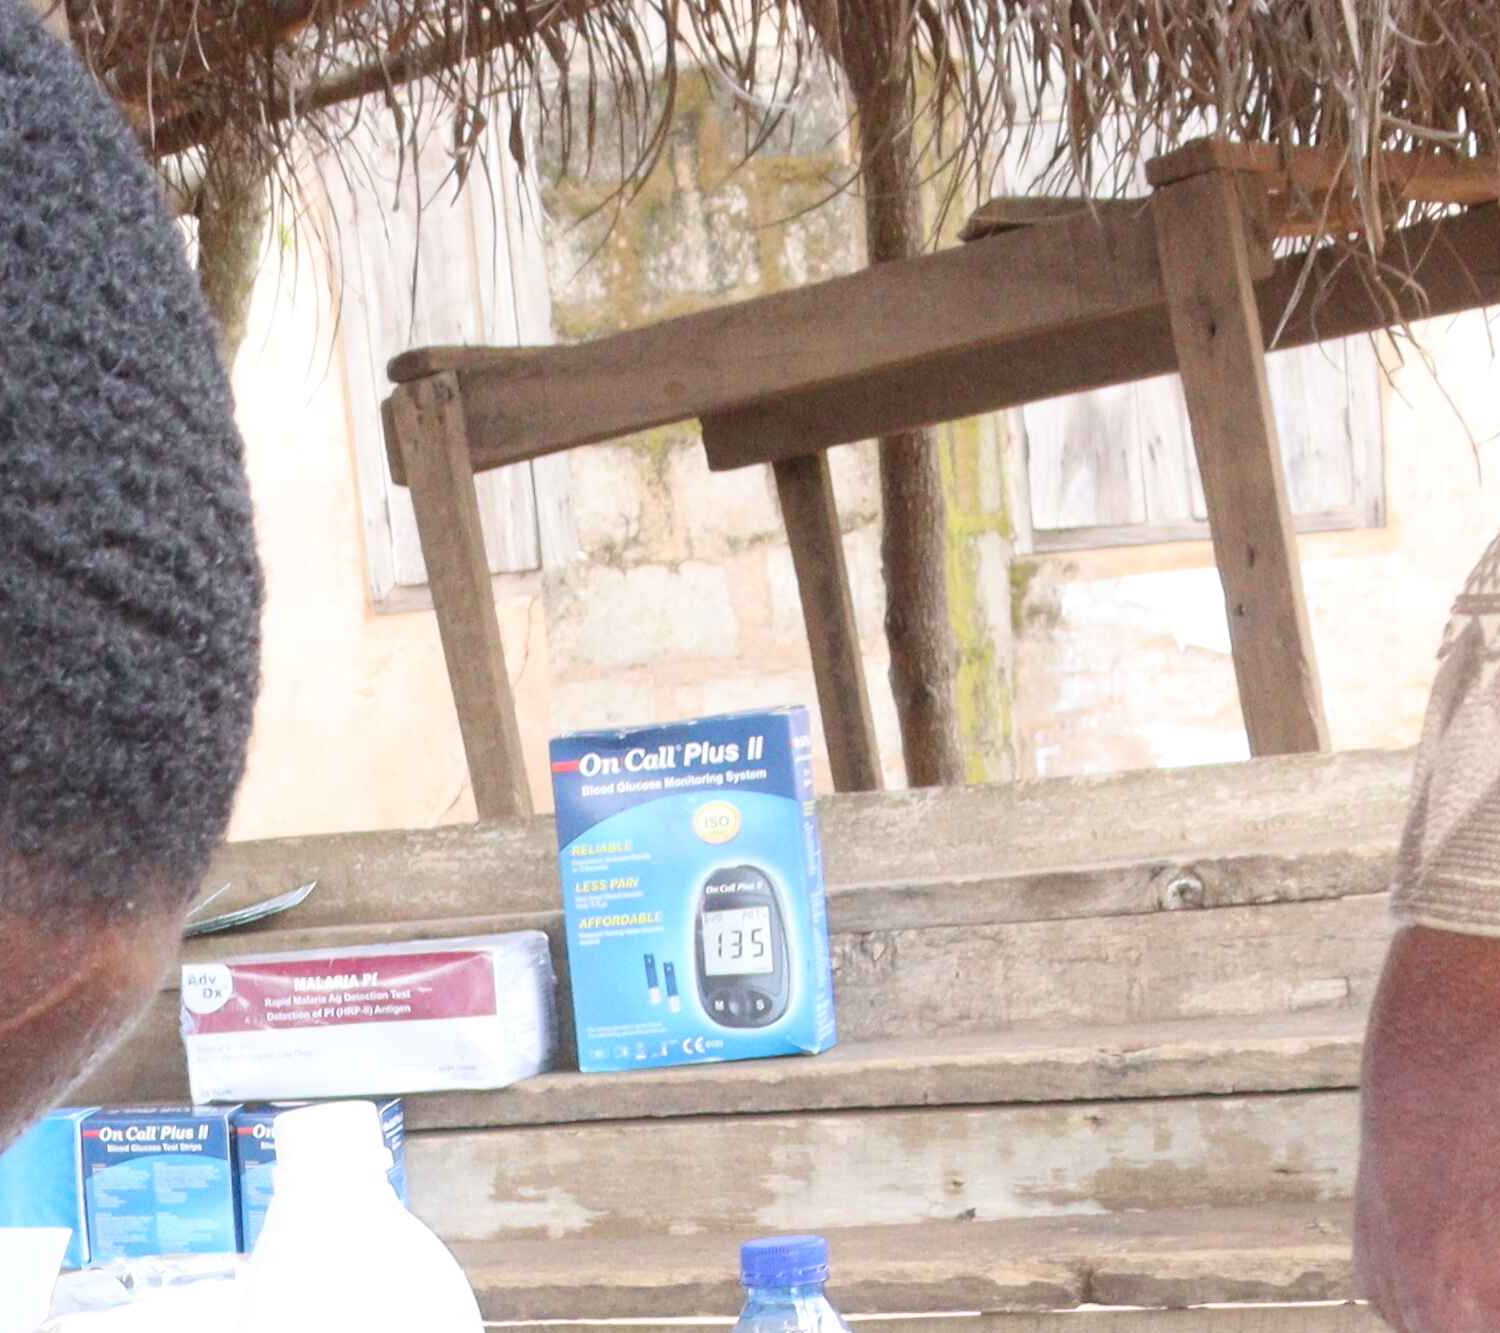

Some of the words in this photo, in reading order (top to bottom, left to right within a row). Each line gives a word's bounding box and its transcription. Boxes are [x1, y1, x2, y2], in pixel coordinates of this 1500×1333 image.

[578, 753, 620, 778] On
[625, 745, 676, 772] Call
[683, 743, 740, 768] Plus
[747, 736, 764, 760] II
[581, 781, 614, 797] Blood
[616, 779, 662, 794] Glucose
[664, 773, 723, 790] Monitoring
[725, 768, 767, 785] System
[703, 815, 730, 829] ISO
[576, 880, 608, 893] LESS
[717, 928, 765, 959] 135
[187, 973, 217, 987] Adv
[293, 974, 358, 993] MALARIA
[202, 987, 223, 999] Dx
[264, 995, 292, 1008] Rapid
[293, 993, 327, 1006] Malaria
[344, 990, 388, 1003] Detection
[390, 988, 411, 1000] Test
[266, 1008, 310, 1022] Detection
[312, 1007, 322, 1018] of
[374, 1003, 412, 1017] Antigen
[100, 1127, 123, 1142] On
[126, 1125, 156, 1141] Call
[160, 1125, 194, 1140] Plus
